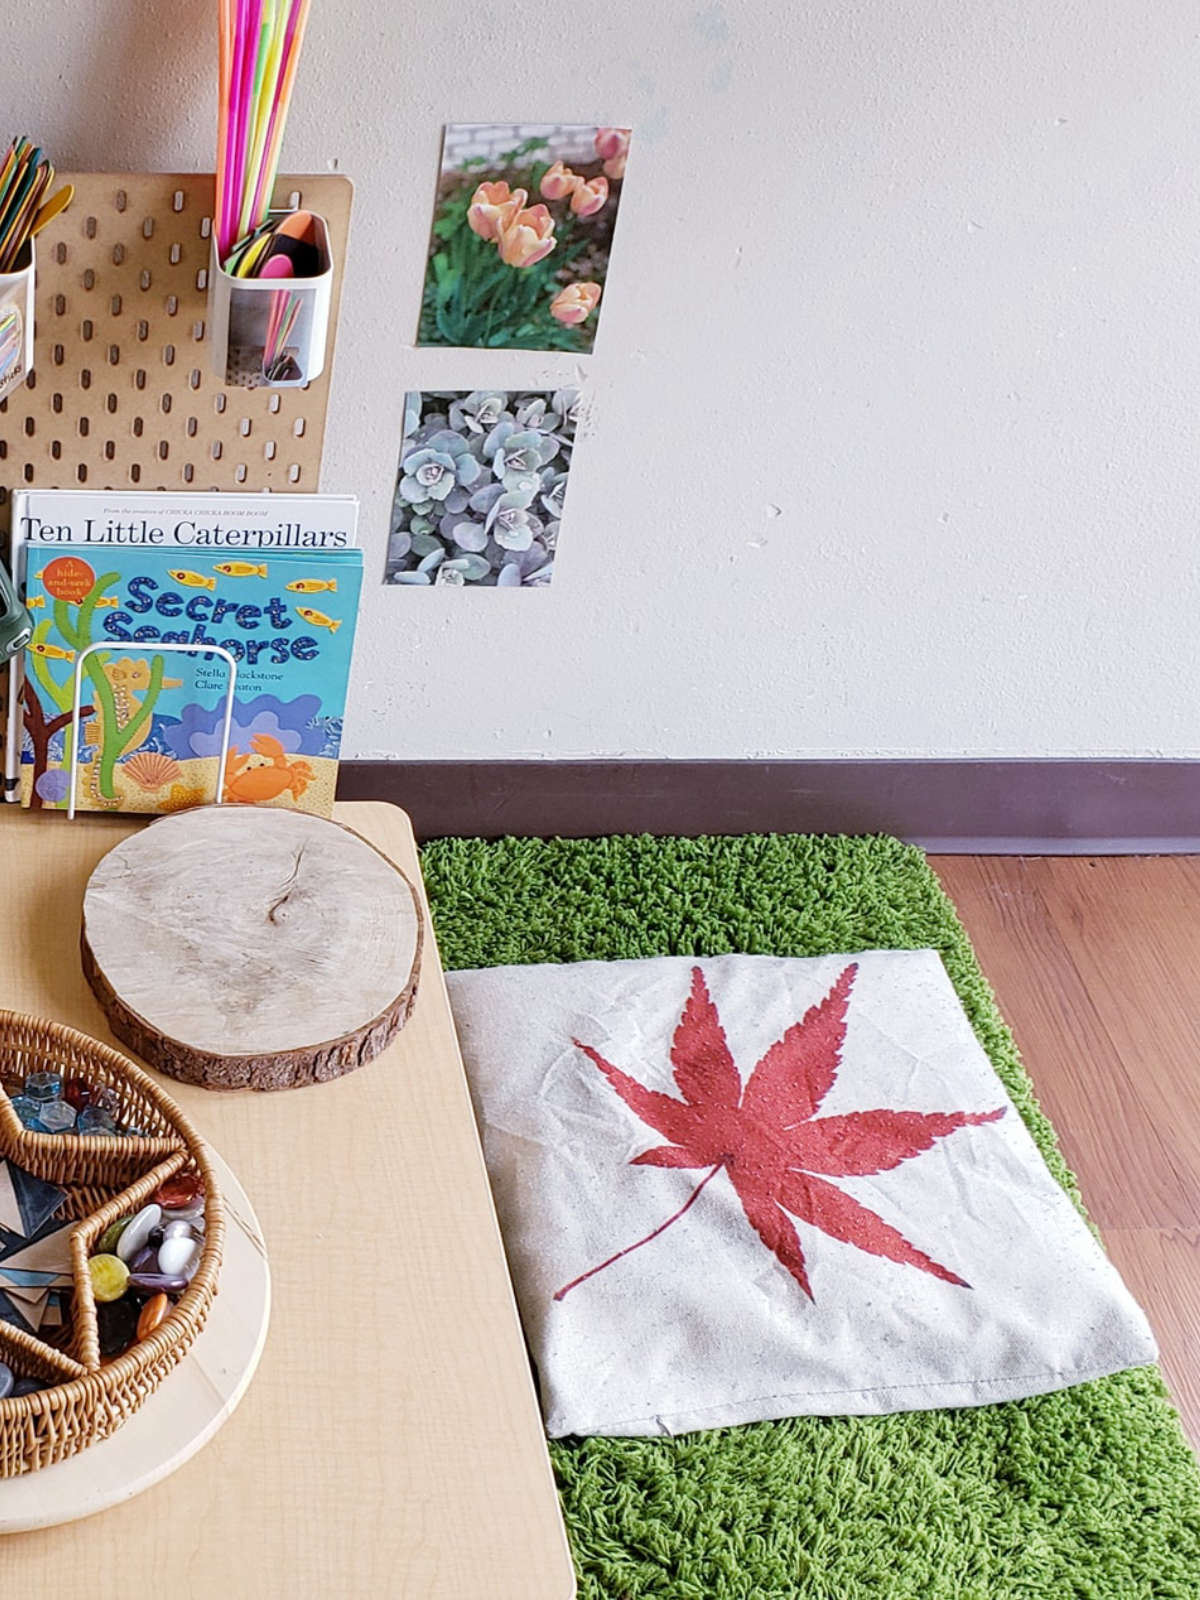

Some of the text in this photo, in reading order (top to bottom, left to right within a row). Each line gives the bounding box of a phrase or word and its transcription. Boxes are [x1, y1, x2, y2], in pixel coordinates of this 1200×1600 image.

[21, 517, 348, 548] Ten Little Caterpillars
[124, 576, 293, 630] Secret
[102, 611, 320, 665] Seahorse
